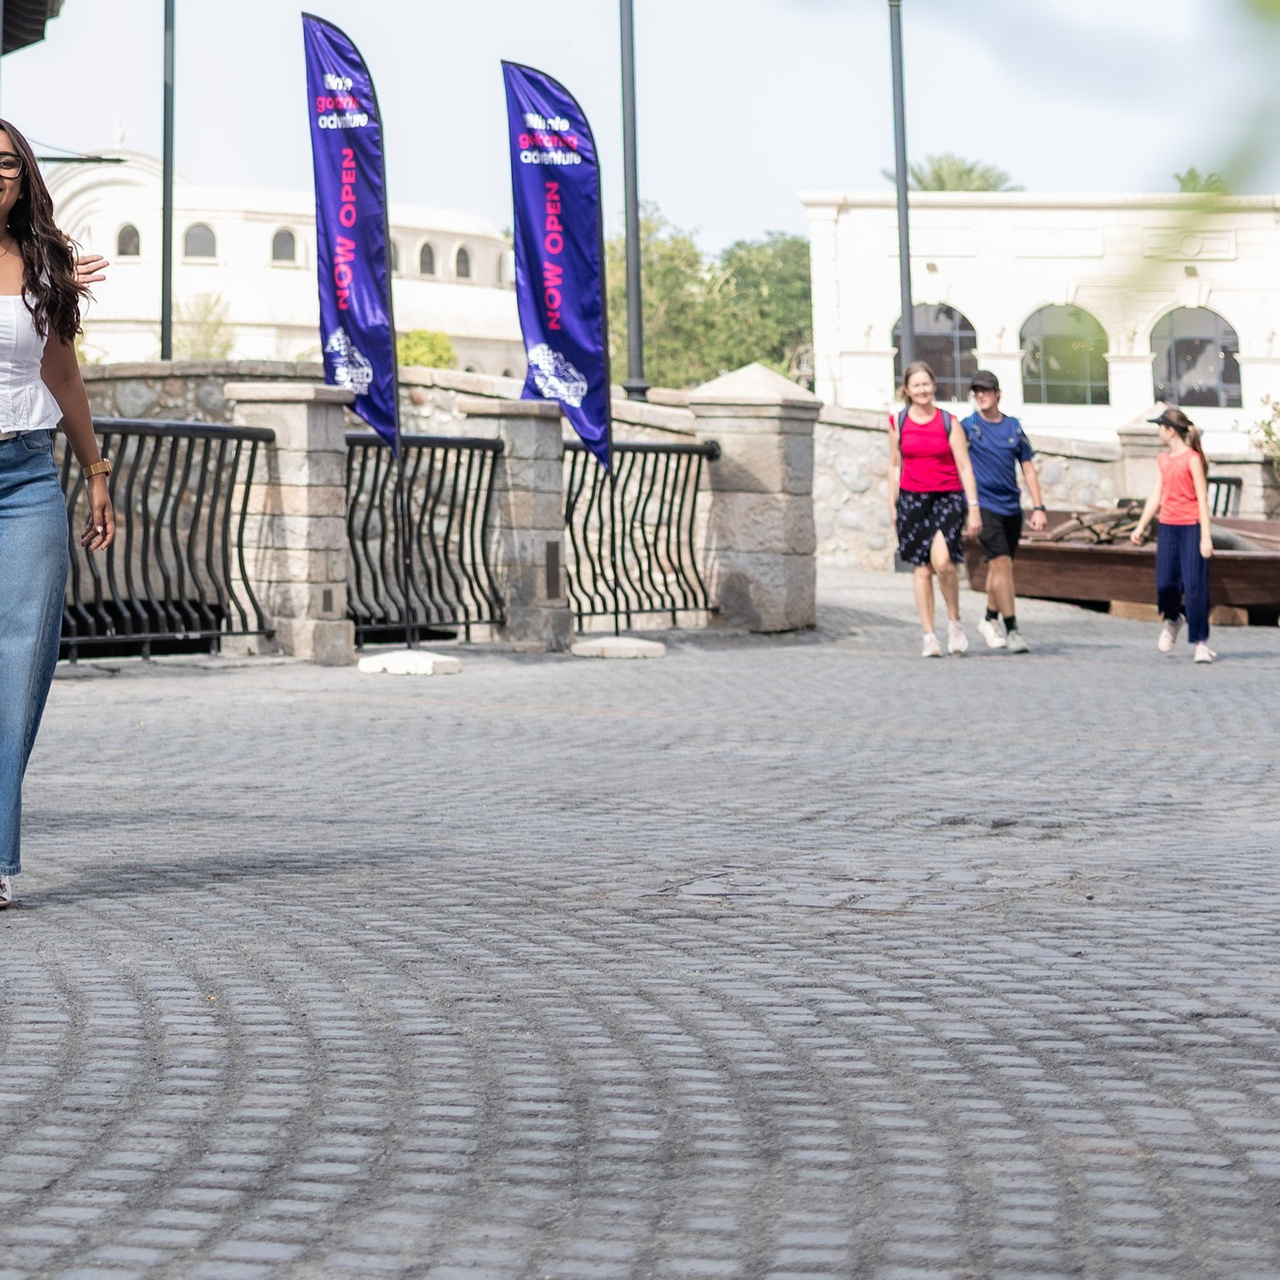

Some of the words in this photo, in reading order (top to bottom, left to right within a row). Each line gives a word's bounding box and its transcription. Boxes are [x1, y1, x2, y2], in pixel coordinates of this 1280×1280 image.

[339, 147, 357, 228] OPEN
[544, 181, 564, 255] OPEN
[334, 235, 356, 311] NOW
[543, 260, 563, 331] NOW
